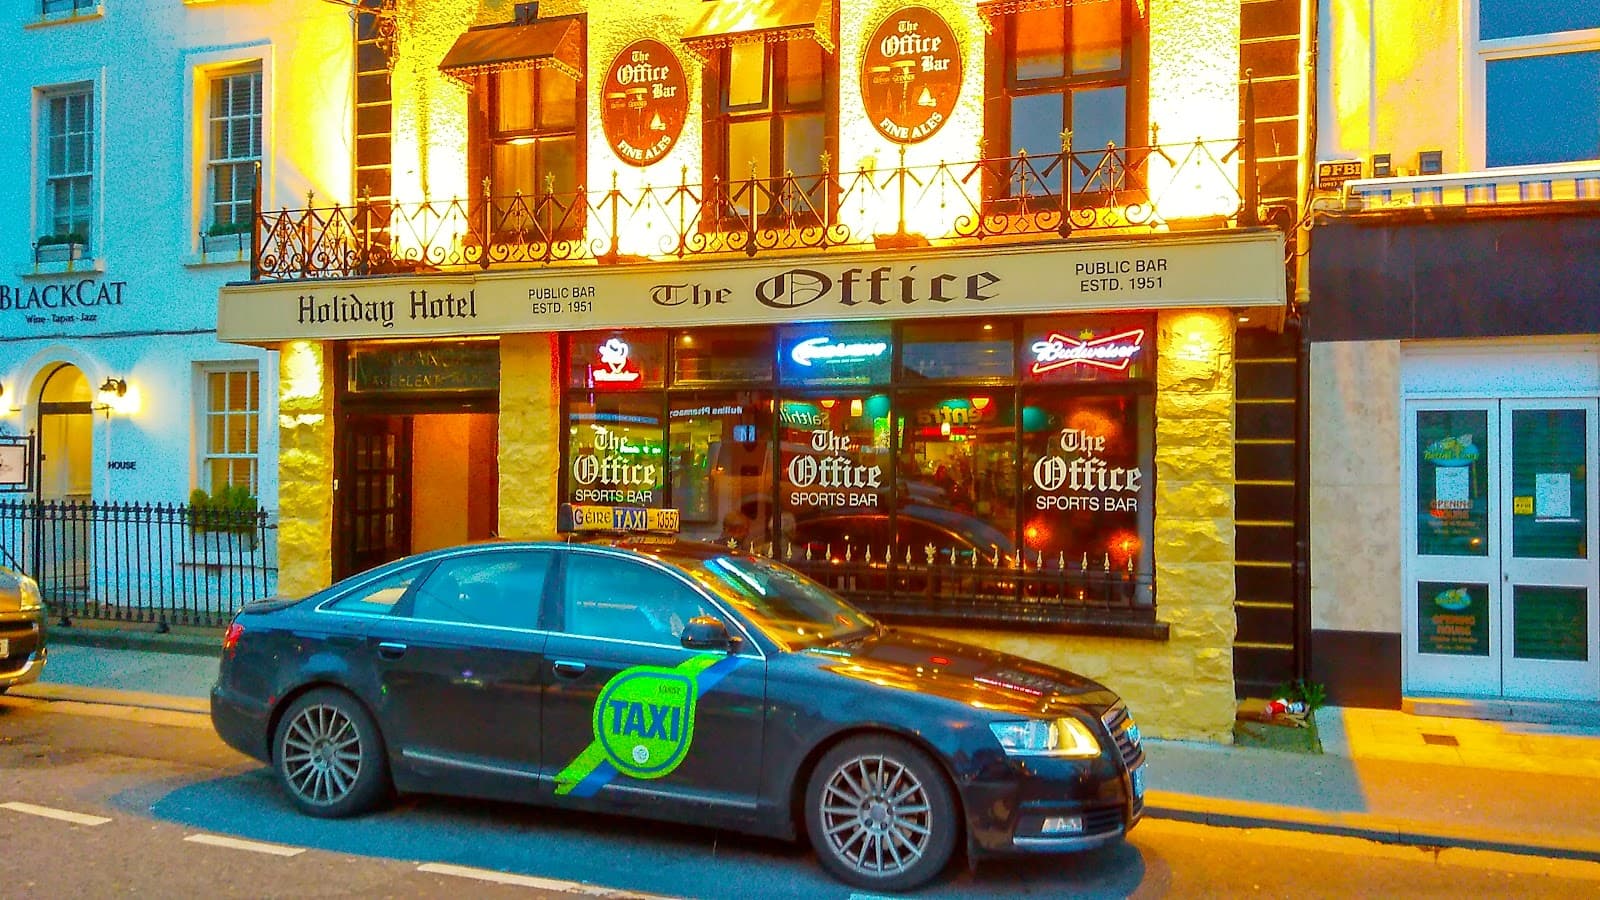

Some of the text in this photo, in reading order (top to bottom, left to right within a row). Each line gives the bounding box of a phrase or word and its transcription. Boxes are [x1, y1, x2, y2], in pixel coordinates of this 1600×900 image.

[898, 20, 919, 34] The
[631, 50, 650, 63] The
[880, 33, 942, 58] Office
[616, 62, 670, 86] Office
[921, 54, 951, 73] Bar
[651, 82, 677, 99] Bar
[879, 111, 943, 139] FINE ALES
[617, 134, 672, 160] FINE ALES
[1075, 258, 1167, 276] PUBLIC BAR
[528, 286, 596, 300] PUBLIC BAR
[649, 265, 1001, 308] The Office
[1080, 276, 1163, 293] ESTD. 1951
[80, 312, 98, 322] Jazz
[297, 288, 477, 329] Holiday Hotel
[532, 301, 593, 314] ESTD. 1951
[1031, 340, 1141, 362] Budweiser
[594, 424, 629, 455] The
[811, 429, 851, 457] The
[1060, 427, 1106, 458] The
[107, 460, 137, 470] HOUSE
[573, 454, 656, 486] Office
[788, 454, 882, 489] Office
[1033, 455, 1143, 492] Office
[575, 488, 653, 504] SPORTS BAR
[790, 491, 879, 507] SPORTS BAR
[1035, 495, 1138, 513] SPORTS BAR
[614, 508, 648, 531] TAXI
[656, 511, 679, 529] 13557
[609, 700, 681, 742] TAXI
